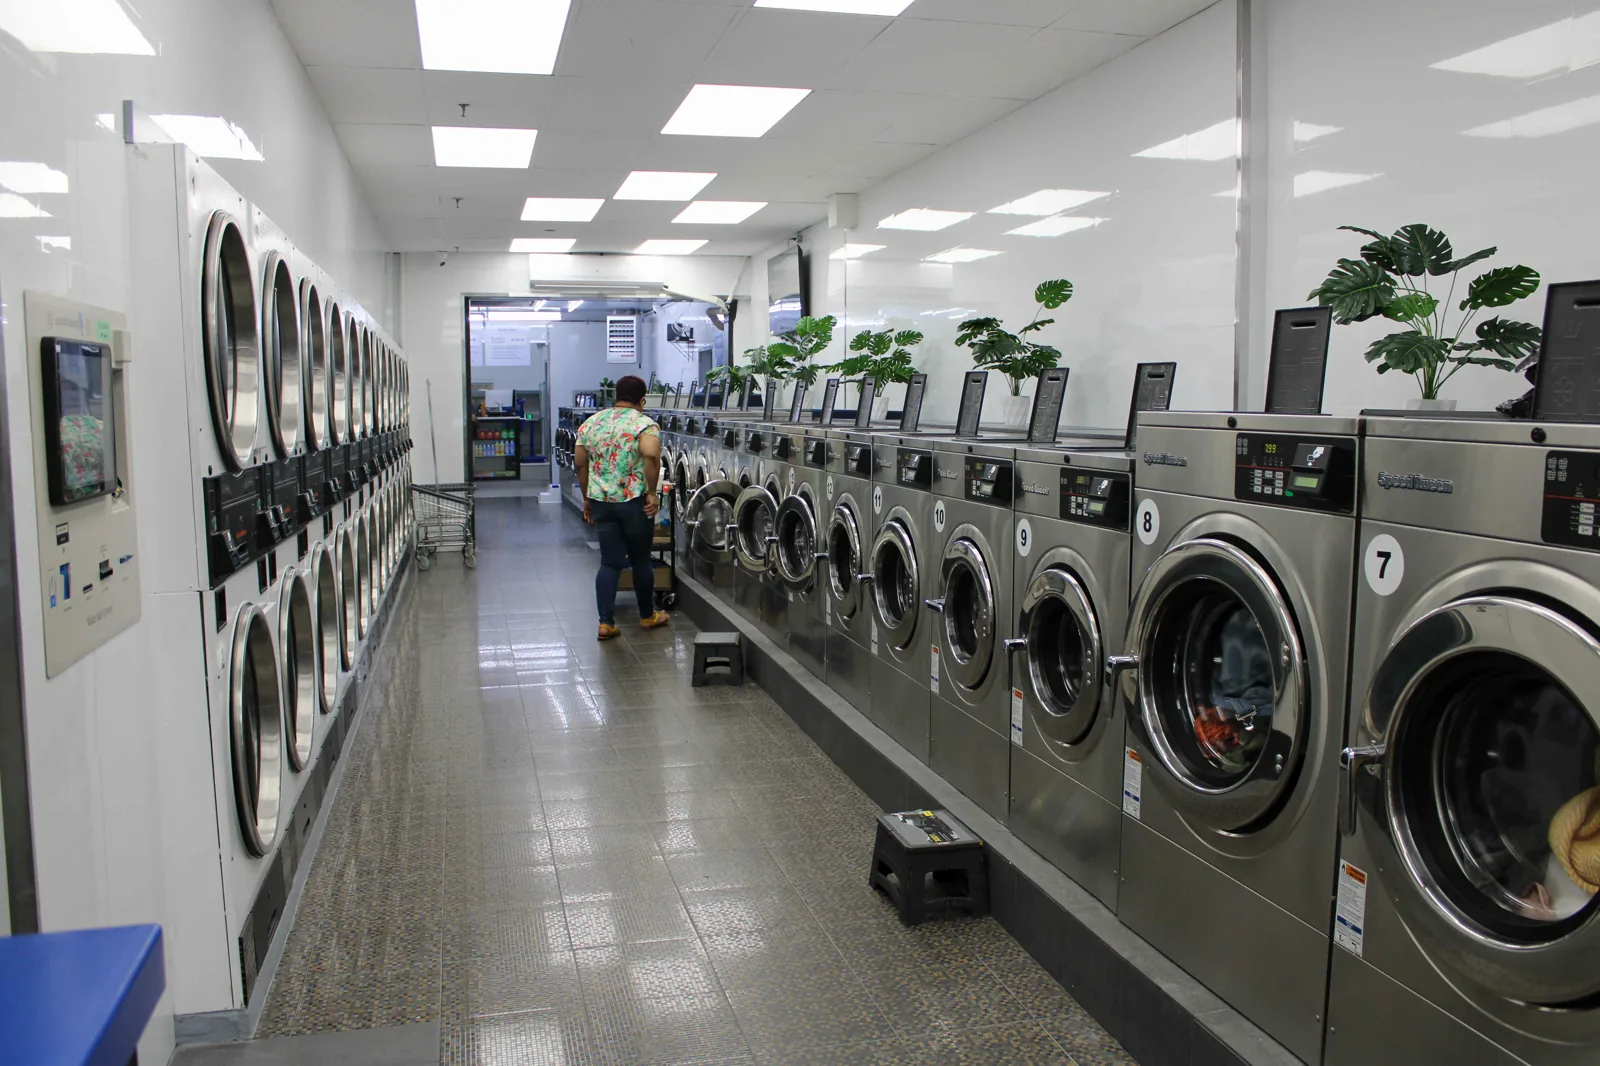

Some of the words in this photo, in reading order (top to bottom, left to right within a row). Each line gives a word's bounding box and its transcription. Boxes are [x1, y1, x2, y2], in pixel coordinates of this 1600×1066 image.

[1378, 472, 1414, 489] Speed
[1414, 474, 1452, 494] Queen
[874, 494, 881, 508] 11
[935, 508, 945, 525] 10
[1143, 511, 1152, 533] 8
[1020, 529, 1027, 547] 9
[1376, 551, 1392, 579] 7
